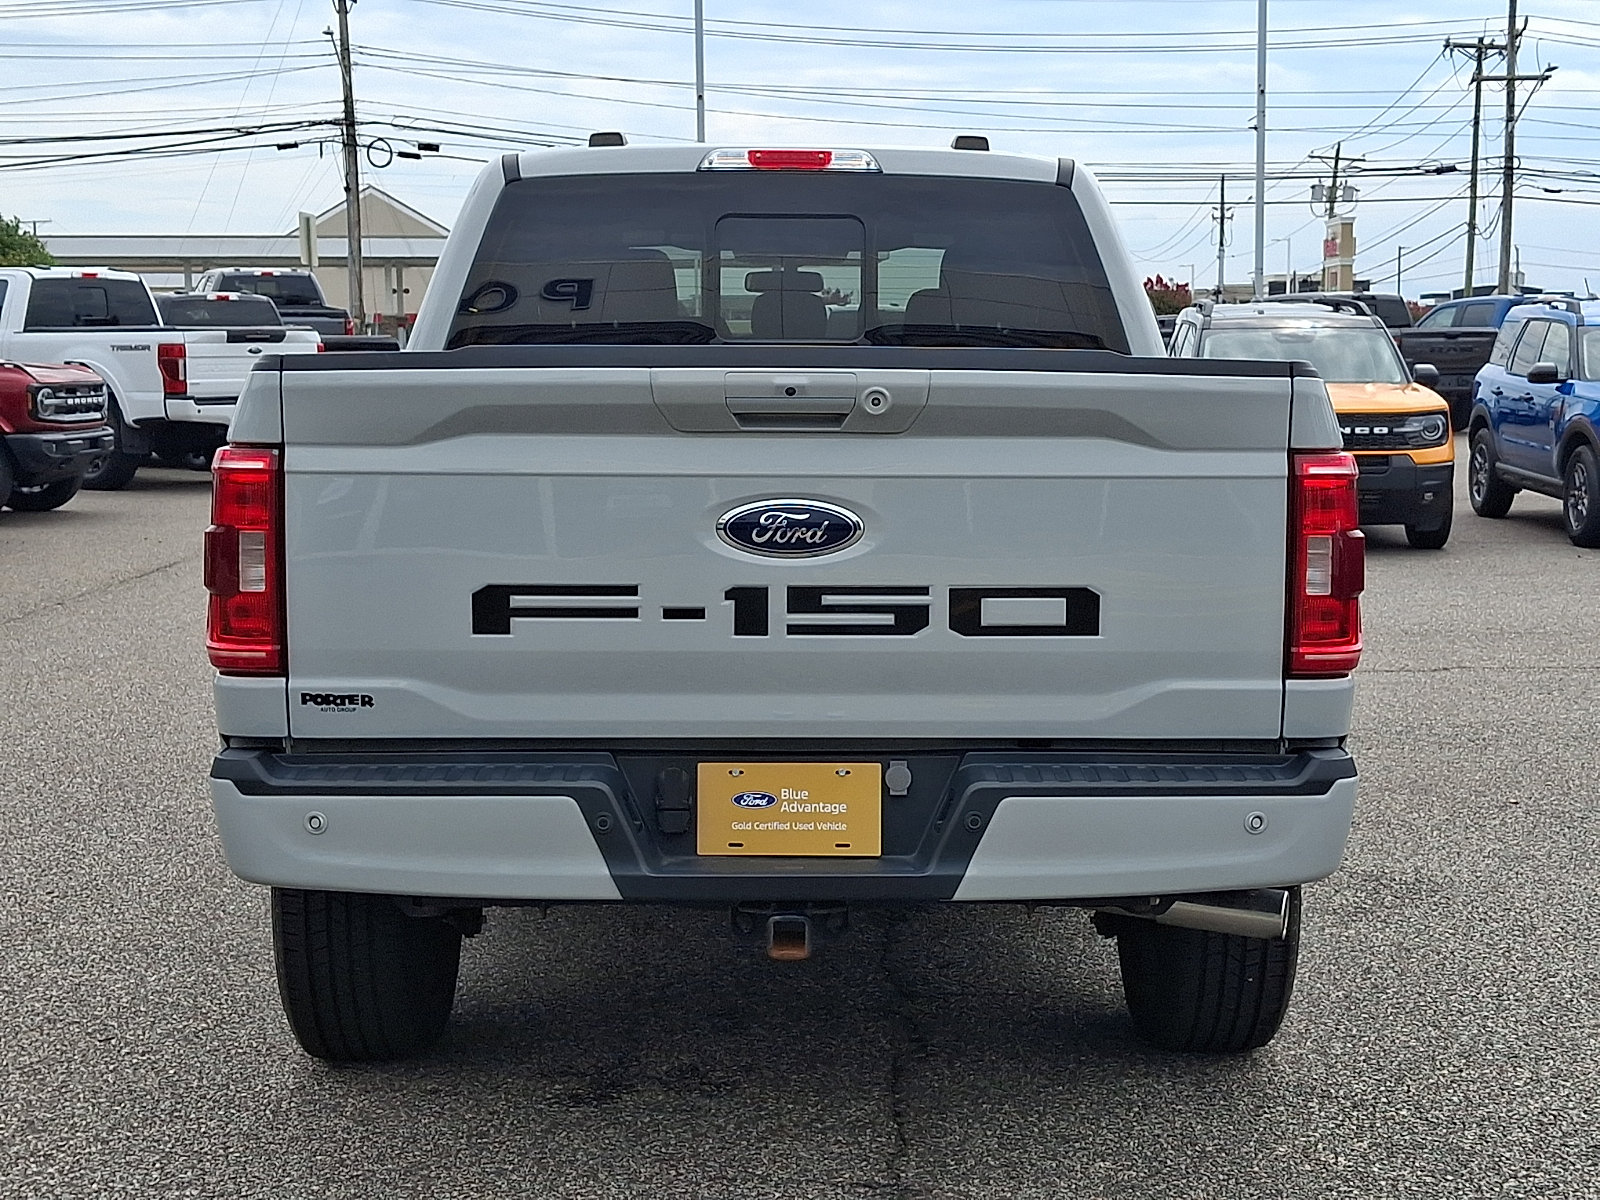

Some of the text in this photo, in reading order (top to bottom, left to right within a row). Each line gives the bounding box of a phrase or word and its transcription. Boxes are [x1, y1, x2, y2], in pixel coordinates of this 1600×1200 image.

[110, 344, 151, 352] TREMOR
[66, 396, 104, 405] BRONCO
[751, 511, 830, 544] Ford
[471, 583, 1102, 637] F-150
[300, 692, 375, 708] PORTER
[780, 788, 809, 800] Blue
[780, 801, 847, 815] Advantage
[731, 821, 847, 831] Gold Certified Used Vehicle
